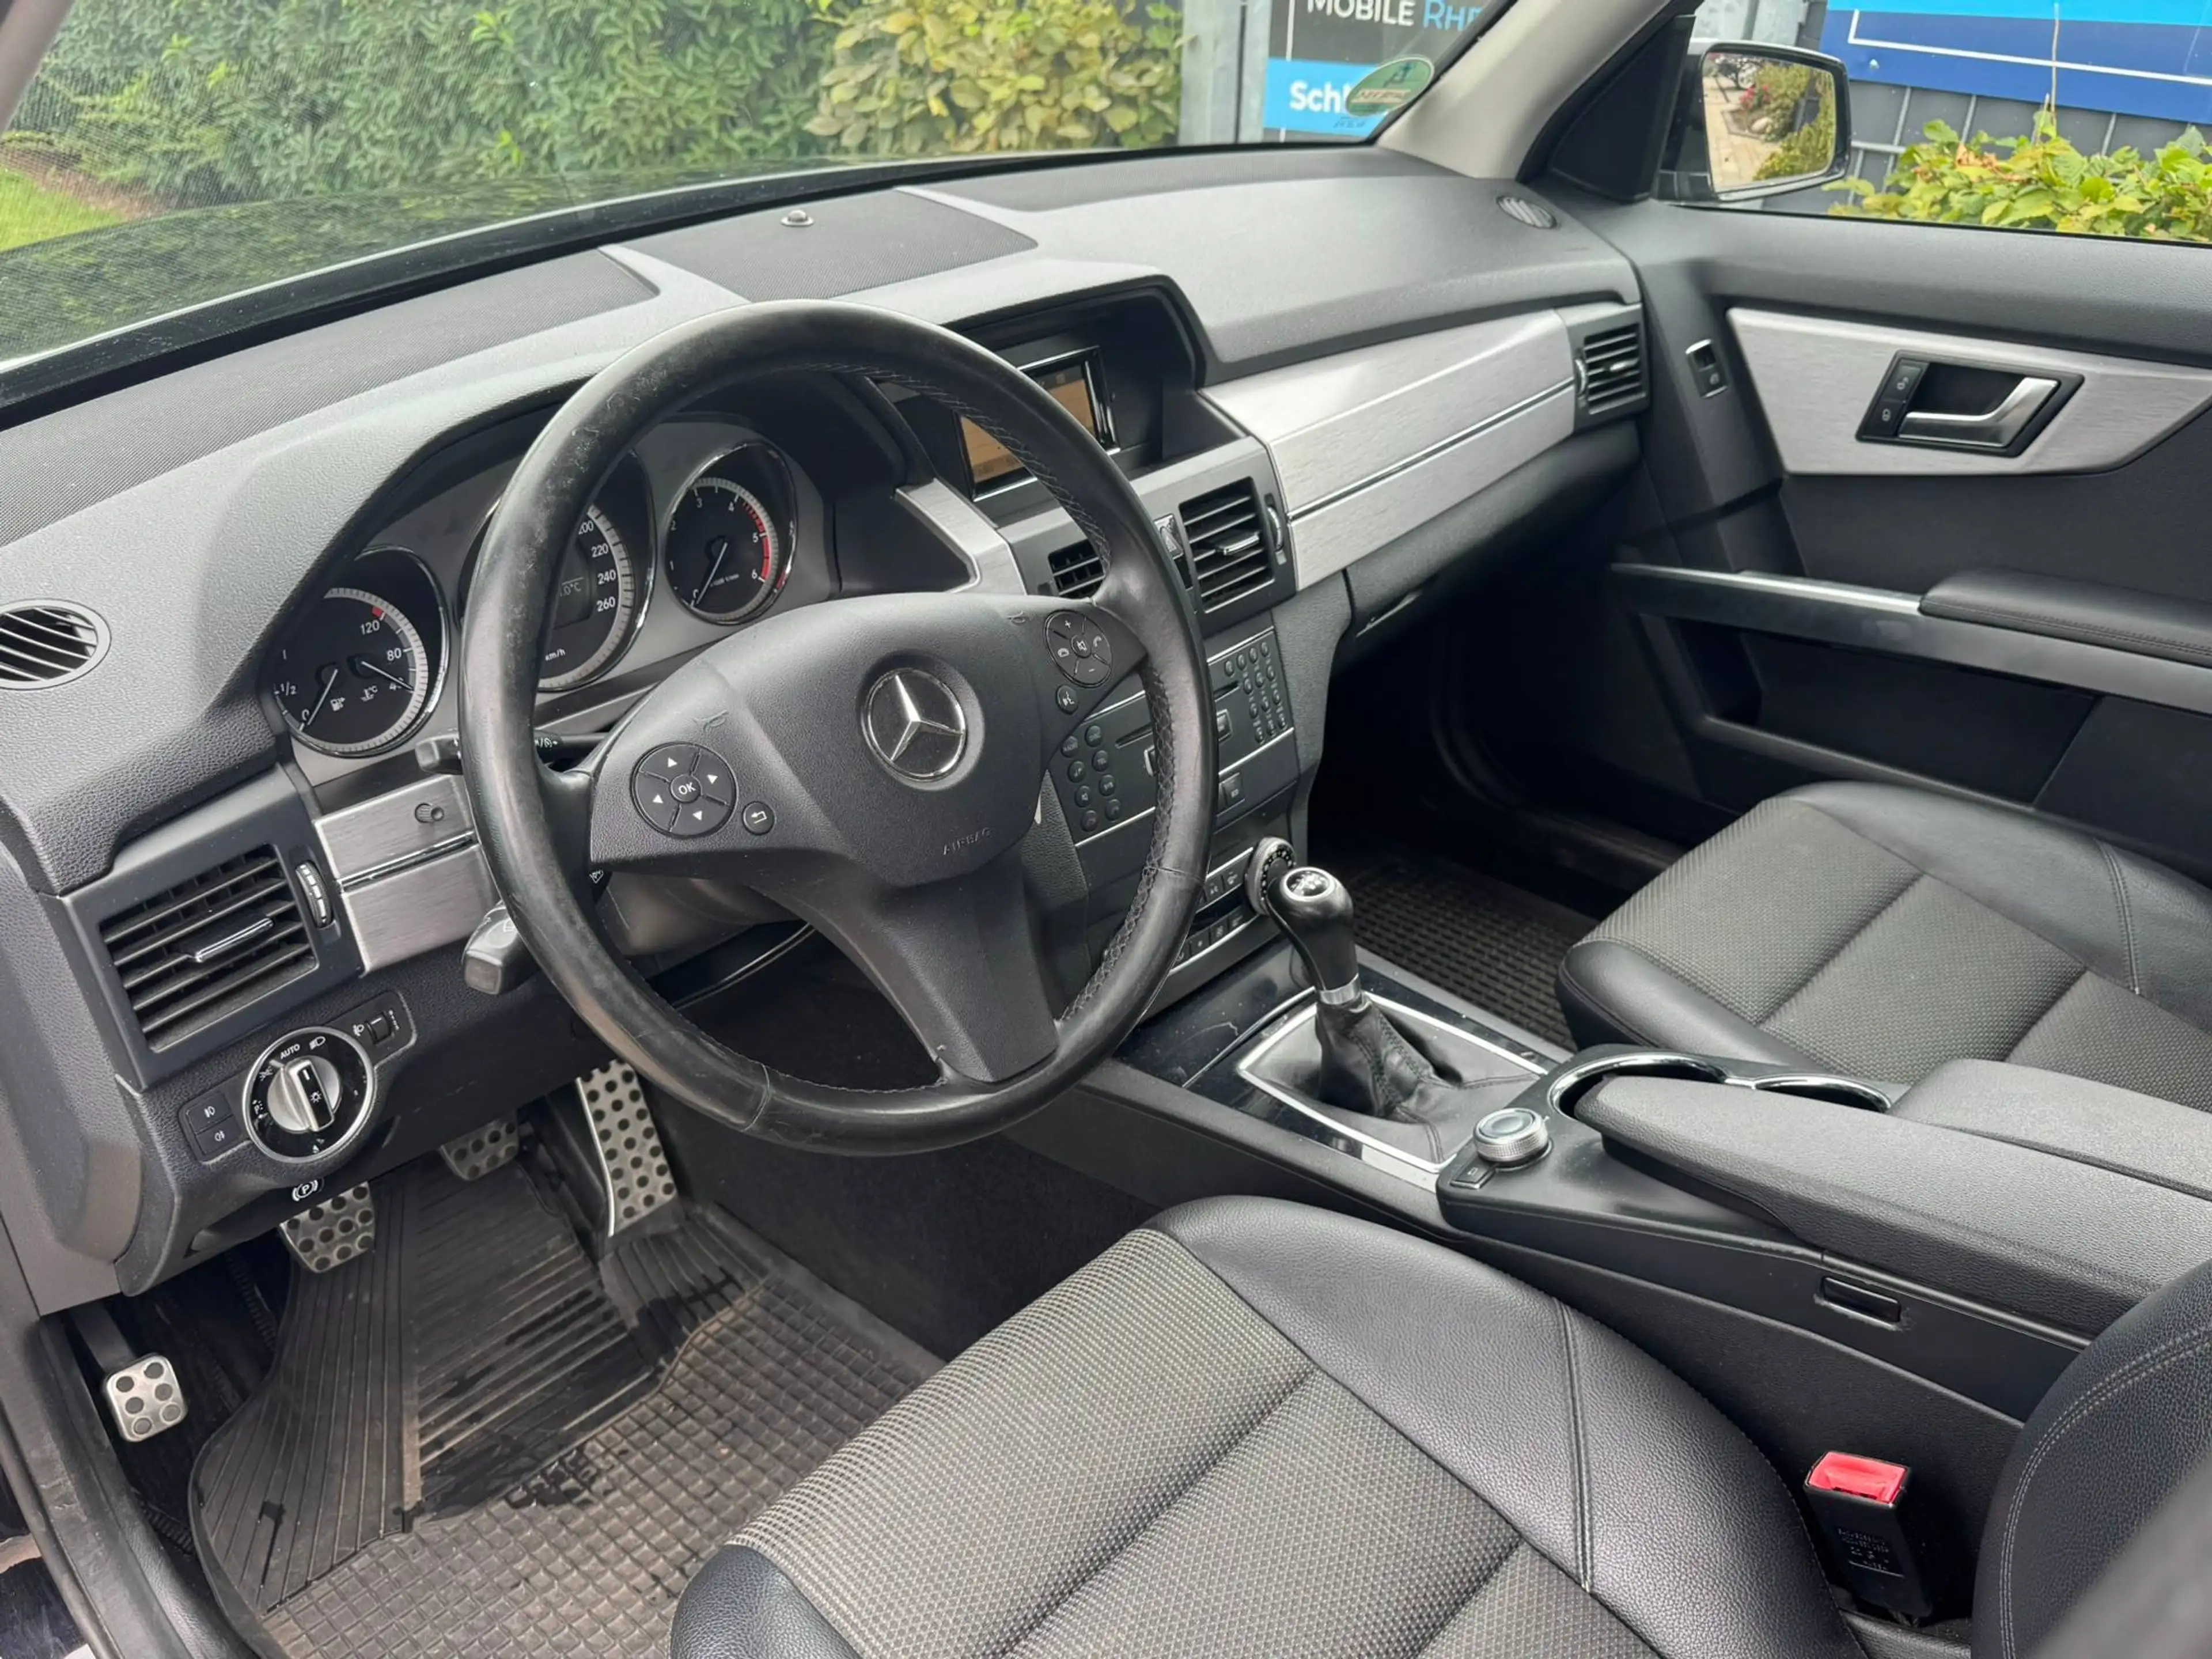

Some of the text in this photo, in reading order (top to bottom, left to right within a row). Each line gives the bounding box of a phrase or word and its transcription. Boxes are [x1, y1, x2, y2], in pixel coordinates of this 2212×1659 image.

[1308, 0, 1415, 26] MOBILE
[752, 532, 759, 543] 5
[590, 543, 609, 558] 220
[597, 569, 616, 585] 240
[751, 569, 758, 579] 6
[596, 596, 616, 612] 260
[359, 620, 380, 635] 120
[386, 647, 402, 661] 80
[677, 781, 697, 796] OK
[280, 1043, 301, 1060] AUTO
